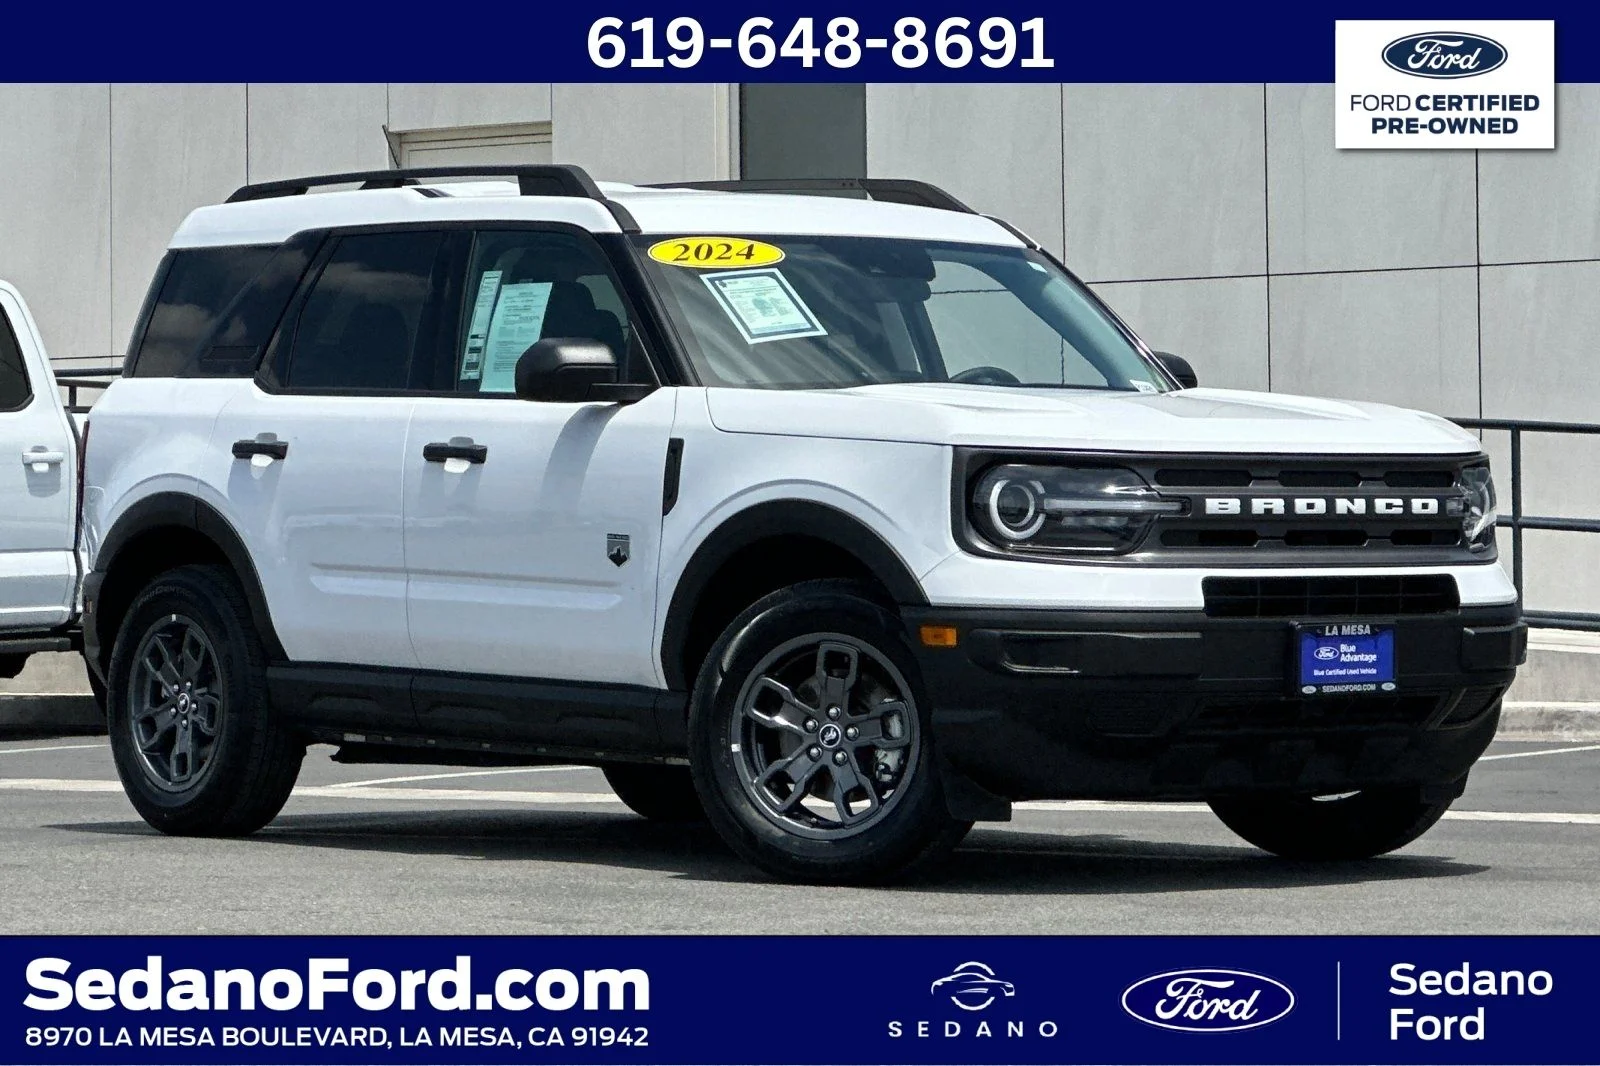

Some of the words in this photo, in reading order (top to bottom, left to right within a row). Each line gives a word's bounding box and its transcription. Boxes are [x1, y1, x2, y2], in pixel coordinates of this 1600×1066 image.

[672, 243, 755, 262] 2024
[1205, 497, 1439, 515] BRONCO
[1325, 625, 1338, 636] LA
[1341, 624, 1371, 635] MESA
[1340, 644, 1356, 653] Blue
[1340, 653, 1377, 663] Advantage
[1325, 668, 1346, 676] Certified
[1360, 667, 1377, 675] Vehicle
[1322, 683, 1376, 693] SEDANOFORD.COM
